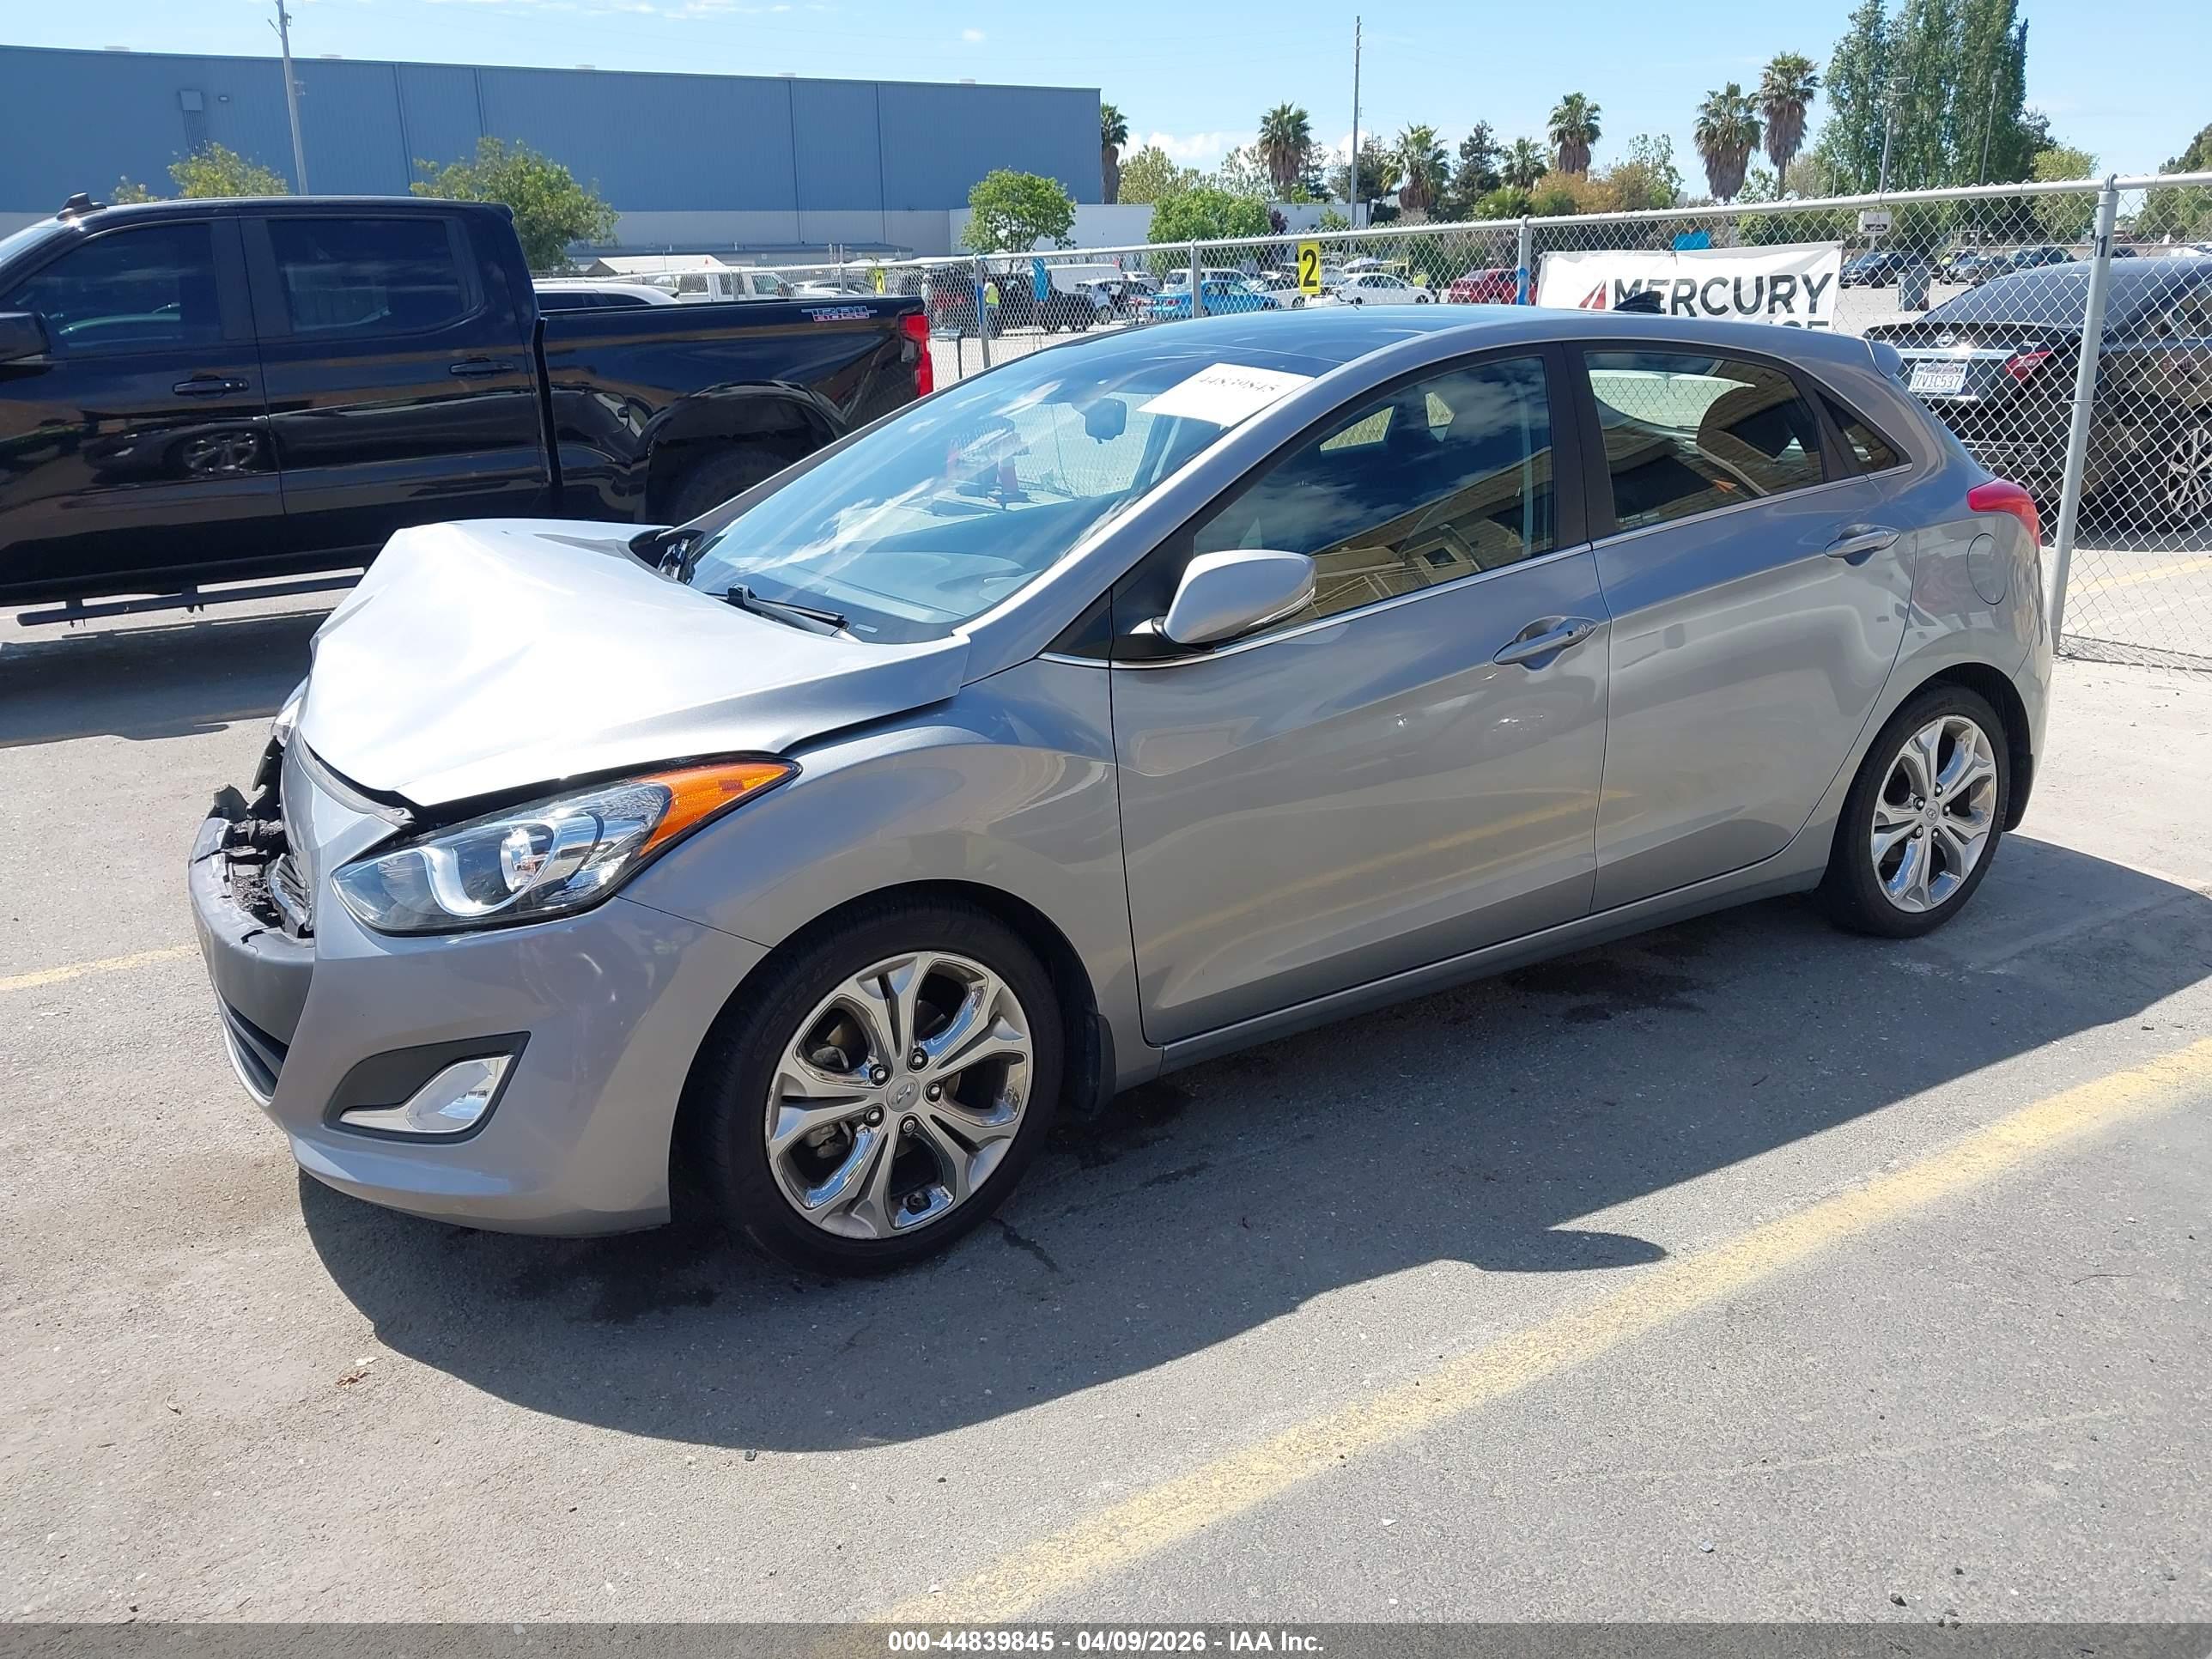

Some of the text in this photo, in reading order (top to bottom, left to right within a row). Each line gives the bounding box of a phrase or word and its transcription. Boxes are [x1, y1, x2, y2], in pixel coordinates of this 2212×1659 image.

[1303, 249, 1317, 287] 2
[1614, 272, 1833, 317] MERCURY
[1915, 374, 1961, 388] 7VIC537
